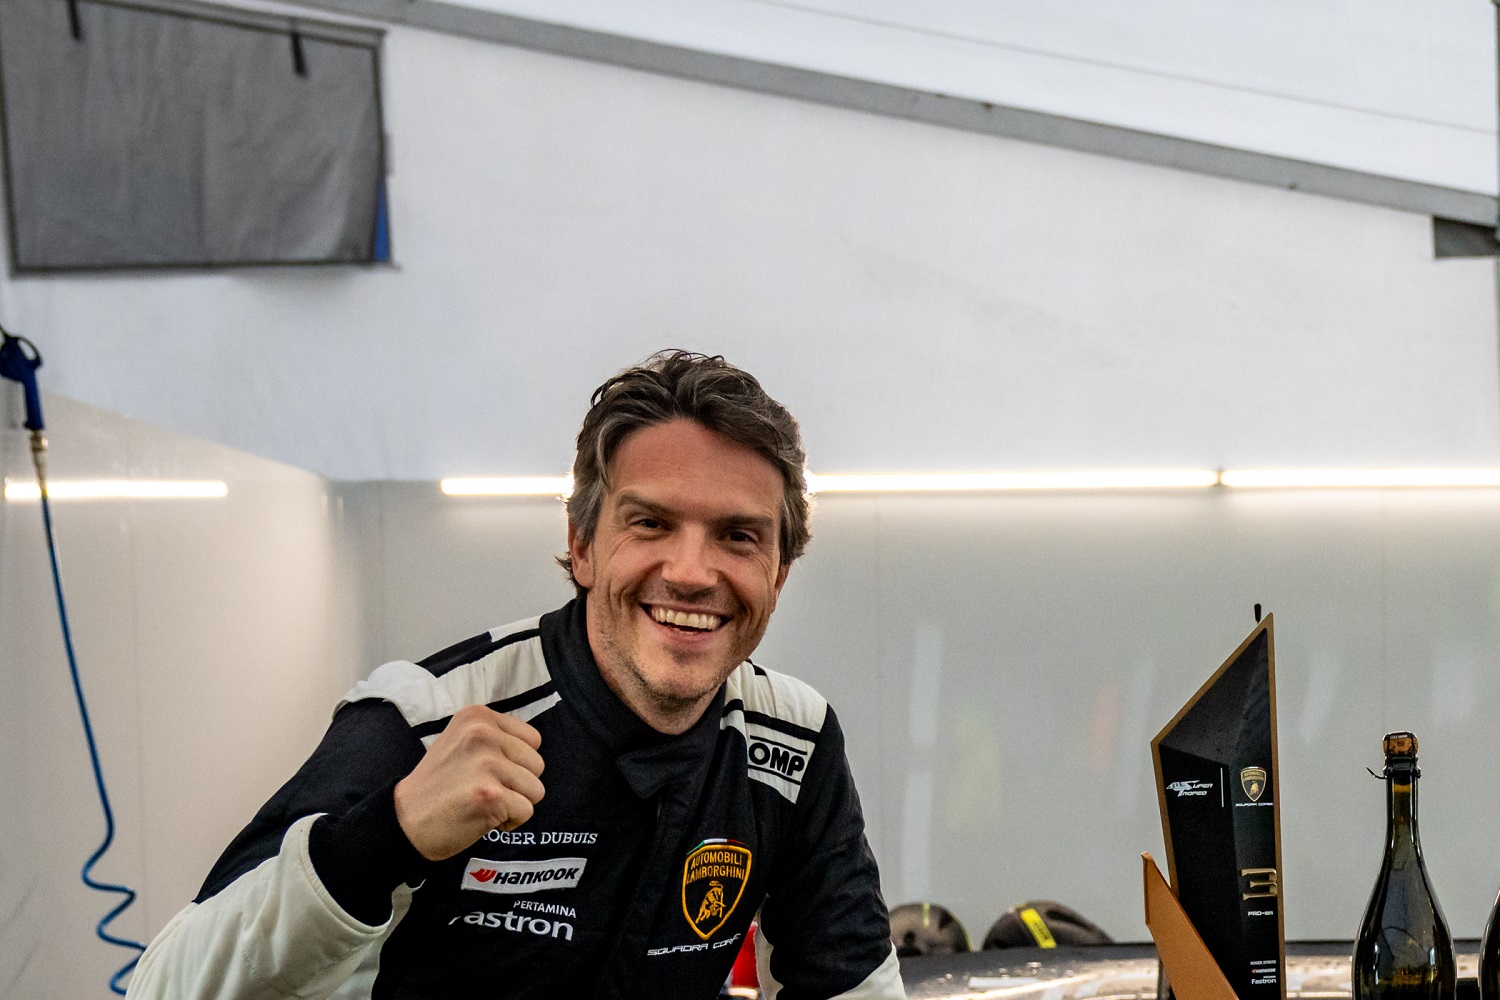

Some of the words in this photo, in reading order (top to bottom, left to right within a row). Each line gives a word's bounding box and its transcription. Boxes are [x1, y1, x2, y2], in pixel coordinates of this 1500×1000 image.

[748, 742, 805, 776] OMP
[483, 829, 536, 845] OGER
[540, 832, 598, 845] DUBUIS
[690, 851, 743, 870] AUTOMOBILI
[686, 865, 745, 885] LAMBORGHINI
[1241, 868, 1277, 900] 3
[513, 900, 577, 918] PERTAMINA
[448, 911, 574, 941] astron
[647, 943, 709, 956] SQUADRA
